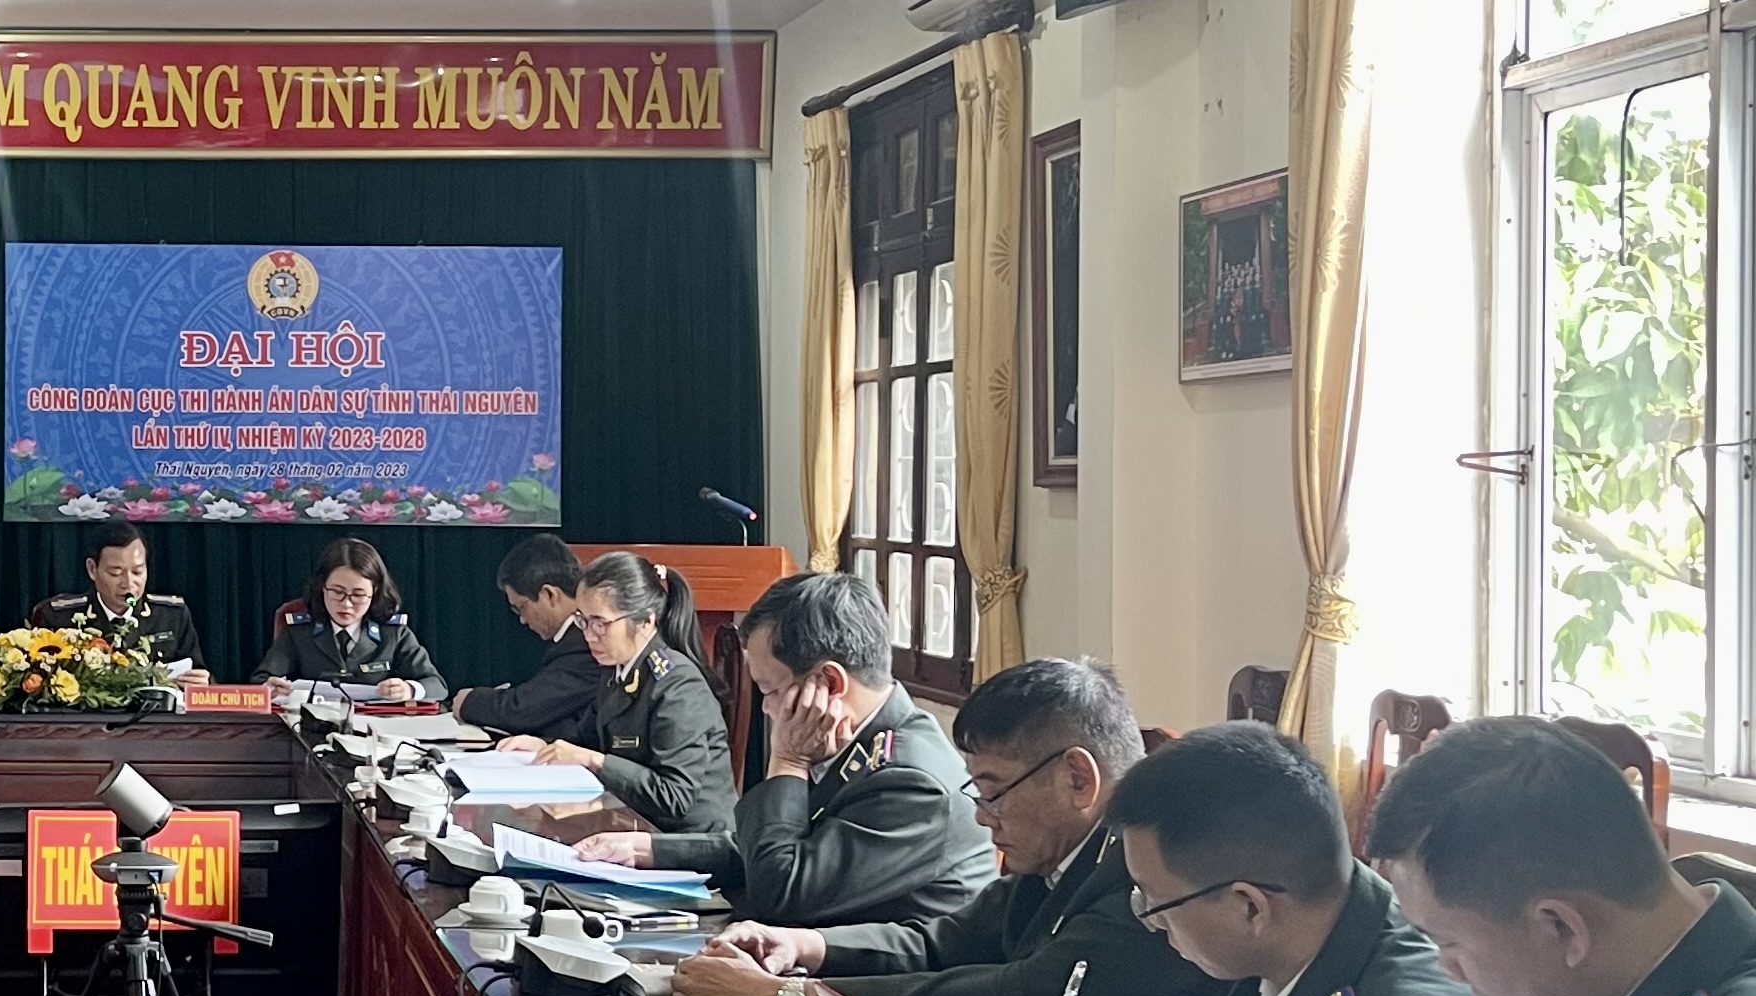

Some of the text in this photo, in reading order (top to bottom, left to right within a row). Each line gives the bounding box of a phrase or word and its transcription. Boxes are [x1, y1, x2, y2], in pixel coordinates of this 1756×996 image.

[42, 63, 243, 143] QUANG
[258, 66, 399, 130] VINH
[414, 51, 585, 131] MUÔN
[598, 52, 724, 131] NĂM
[180, 321, 385, 377] ĐẠI HỘI
[29, 384, 538, 417] CÔNG ĐOÀN CỤC THI HÀNH ÁN DÂN SỰ TỈNH THÁI NGUYÊN
[133, 420, 170, 449] LẦN
[174, 422, 210, 449] THỨ
[236, 423, 296, 453] NHIỆM
[301, 423, 325, 449] KỲ
[330, 428, 426, 450] 2023-2028
[155, 461, 182, 476] Thái
[236, 463, 267, 478] ngày
[269, 462, 285, 476] 28
[287, 462, 323, 478] tháng
[326, 463, 344, 477] 02
[345, 463, 373, 477] năm
[375, 463, 408, 477] 2023
[220, 689, 241, 706] CHỦ
[243, 693, 265, 709] TỊCH
[41, 833, 104, 906] THÁI
